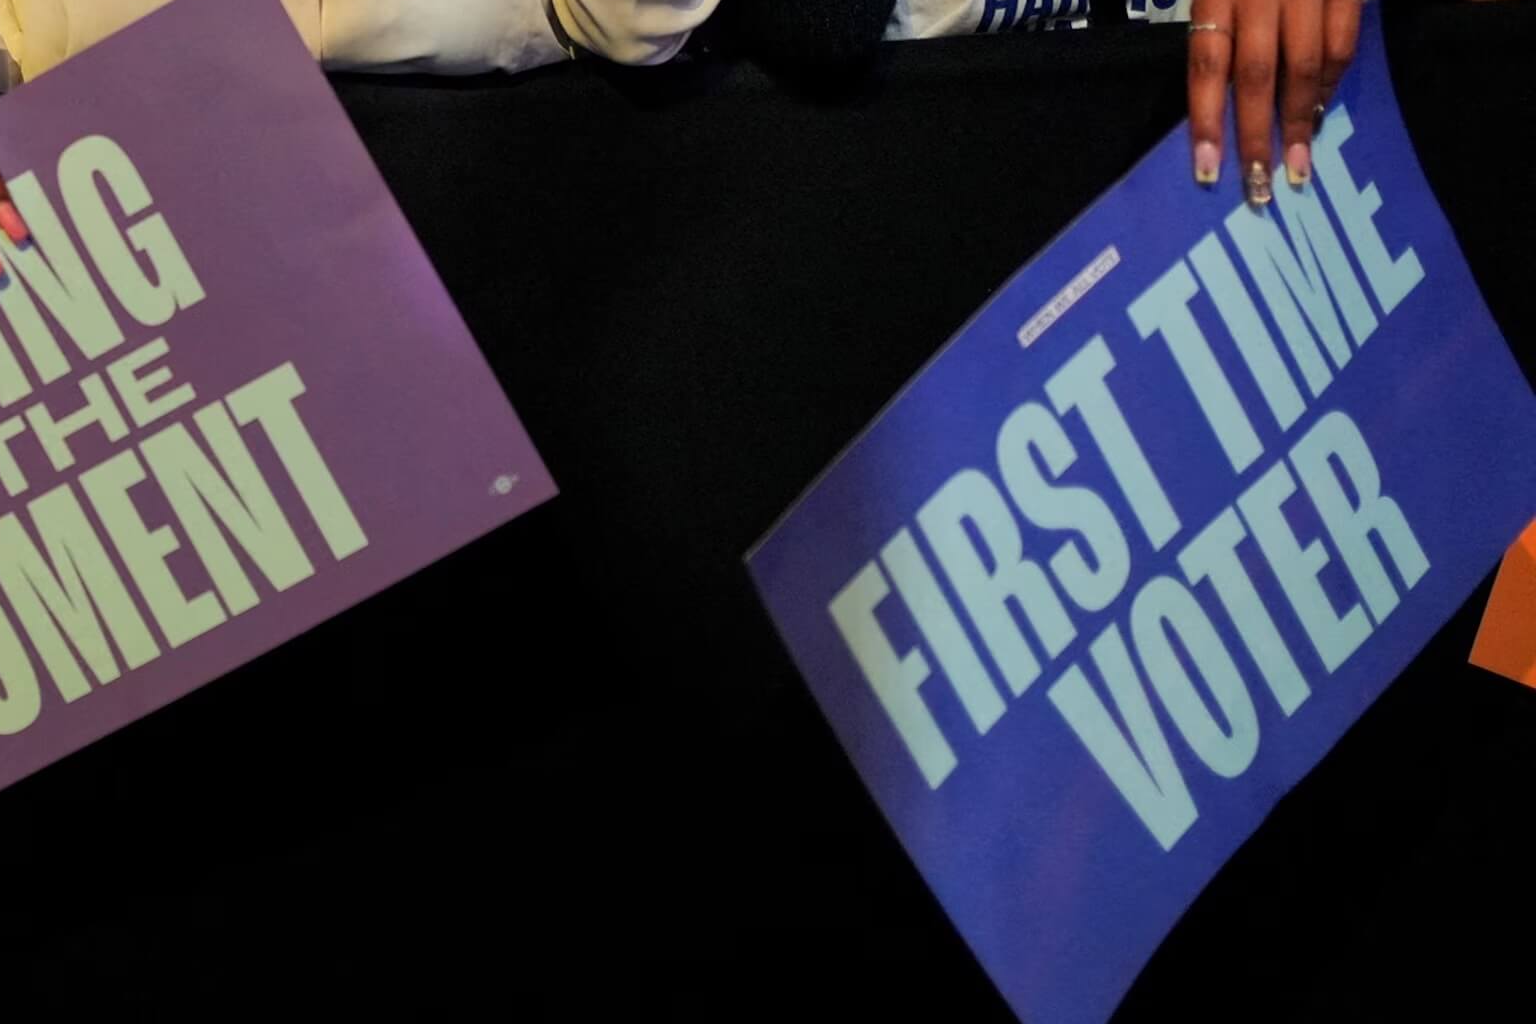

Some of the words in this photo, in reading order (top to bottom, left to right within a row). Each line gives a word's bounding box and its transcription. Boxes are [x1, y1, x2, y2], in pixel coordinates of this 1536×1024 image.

[827, 334, 1181, 791] FIRST
[1126, 103, 1425, 474] TIME
[1046, 410, 1431, 852] VOTER
